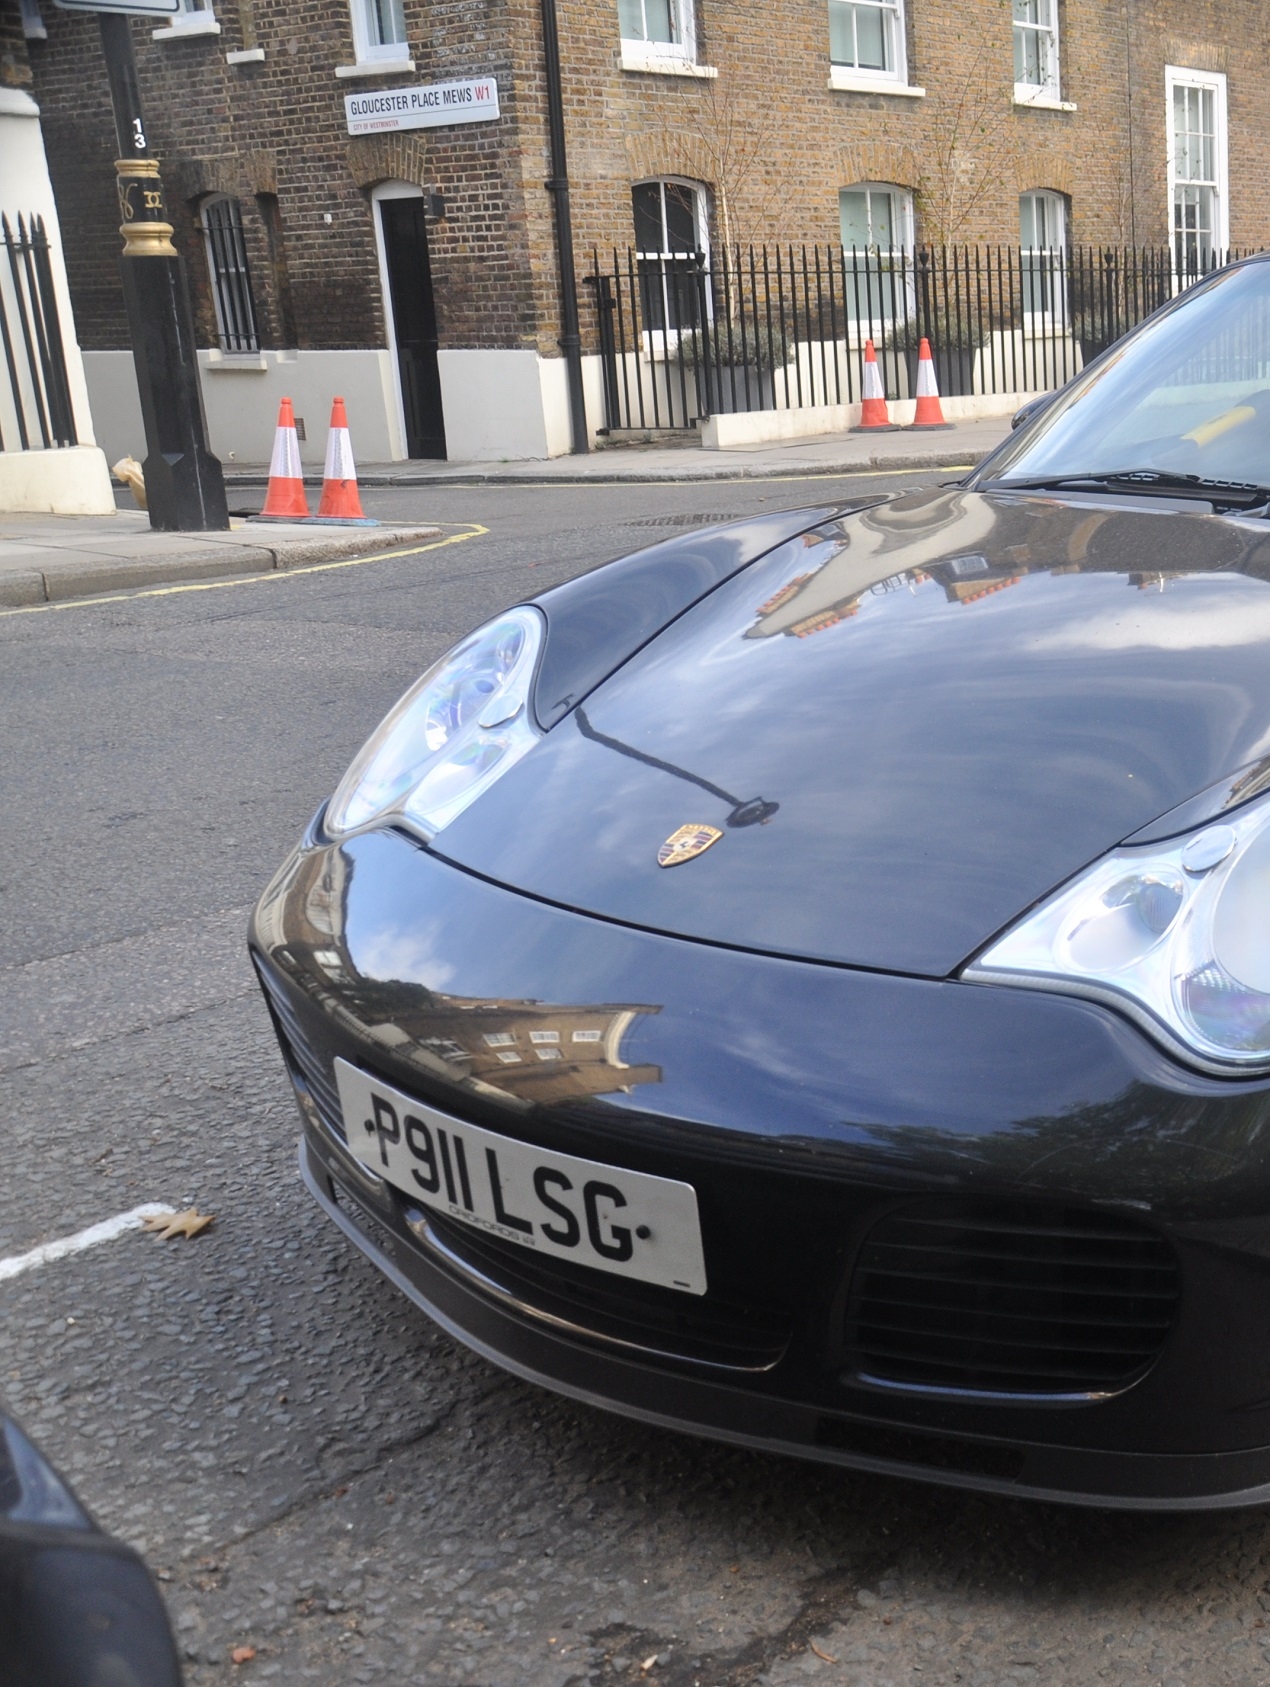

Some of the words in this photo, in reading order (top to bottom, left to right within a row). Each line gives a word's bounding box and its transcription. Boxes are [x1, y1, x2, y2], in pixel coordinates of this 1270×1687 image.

[351, 95, 409, 116] GLOUCESTER
[411, 92, 441, 109] PLACE
[443, 87, 473, 104] MEWS
[475, 85, 490, 101] W1
[353, 123, 363, 131] CITY
[370, 119, 399, 129] WESTMINSTER
[371, 1092, 475, 1213] P911
[485, 1147, 634, 1263] LSG
